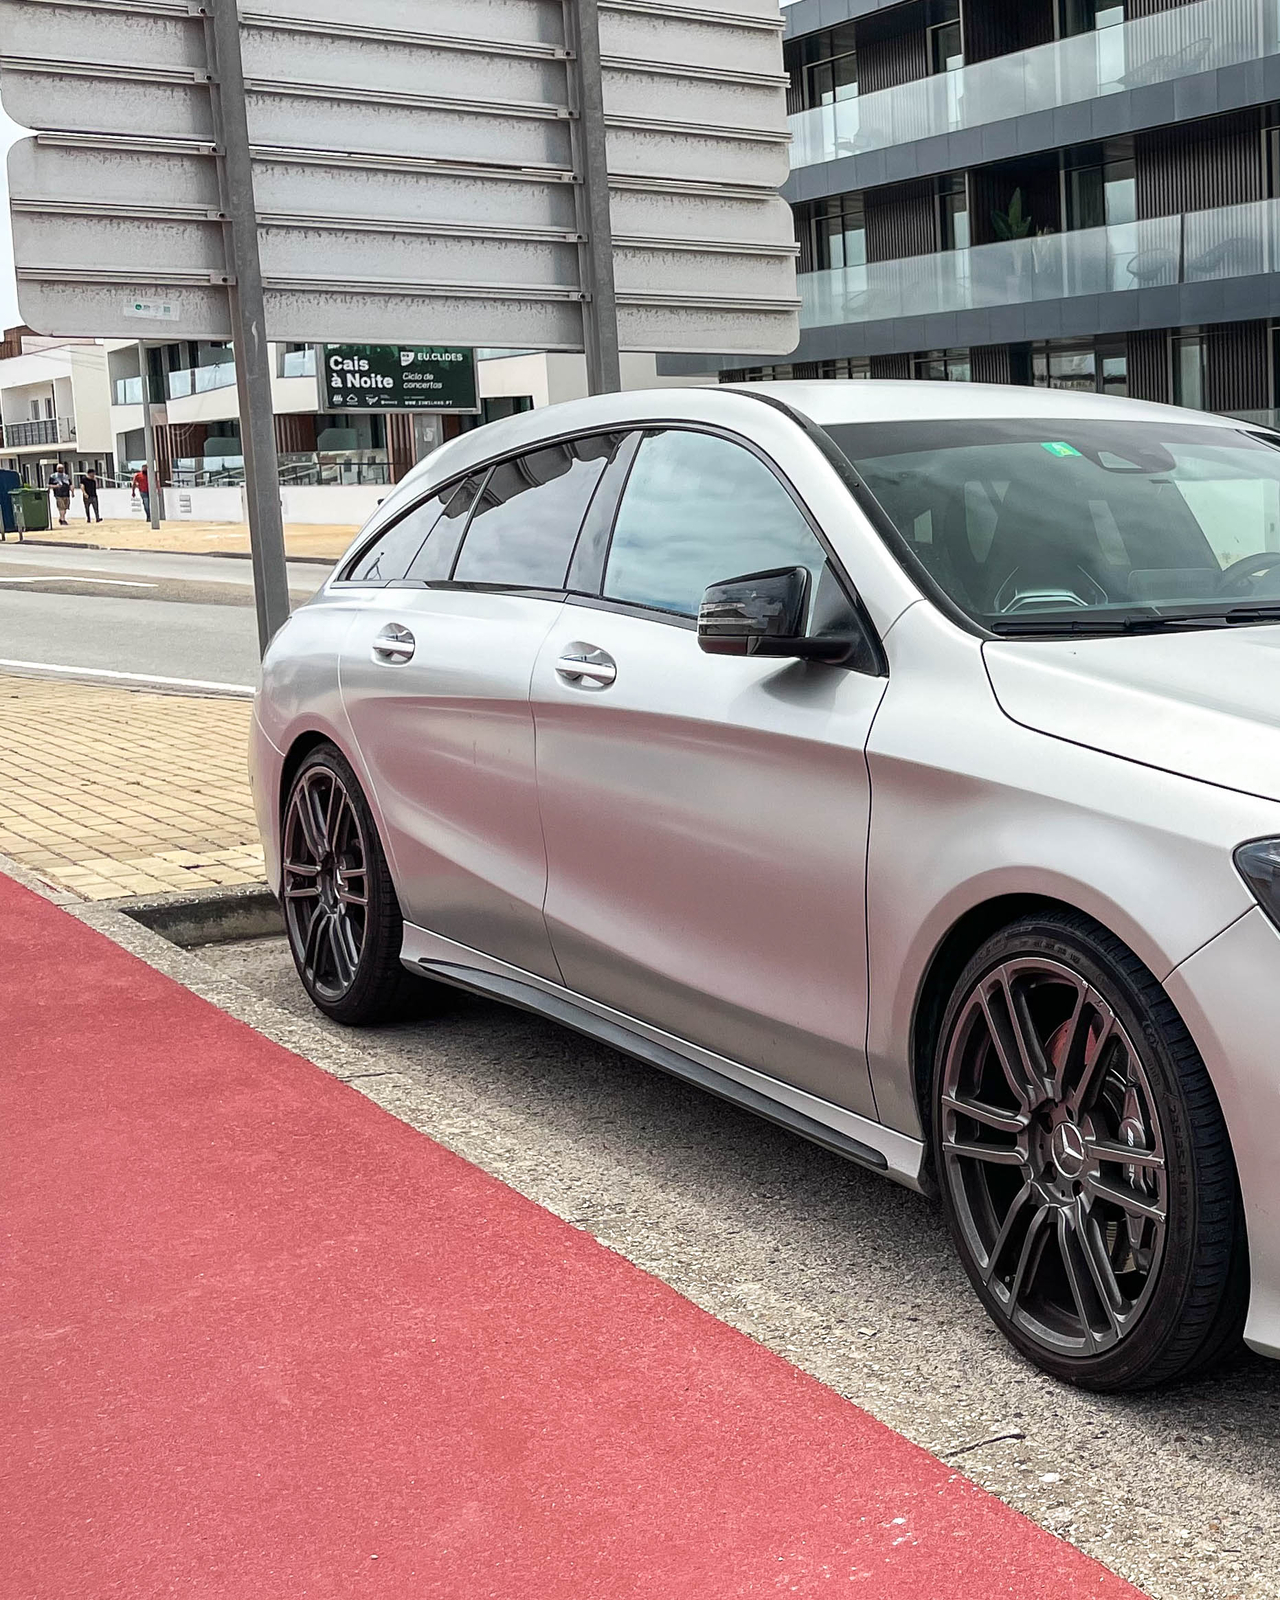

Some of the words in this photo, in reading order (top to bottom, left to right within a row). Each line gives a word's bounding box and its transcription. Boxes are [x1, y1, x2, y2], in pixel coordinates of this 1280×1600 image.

[417, 352, 463, 361] EU.CLIDES
[329, 356, 369, 371] Cais
[402, 372, 422, 380] Ciclo
[423, 372, 434, 380] de
[331, 373, 343, 388] à
[346, 373, 394, 389] Noite
[403, 381, 442, 389] concertos
